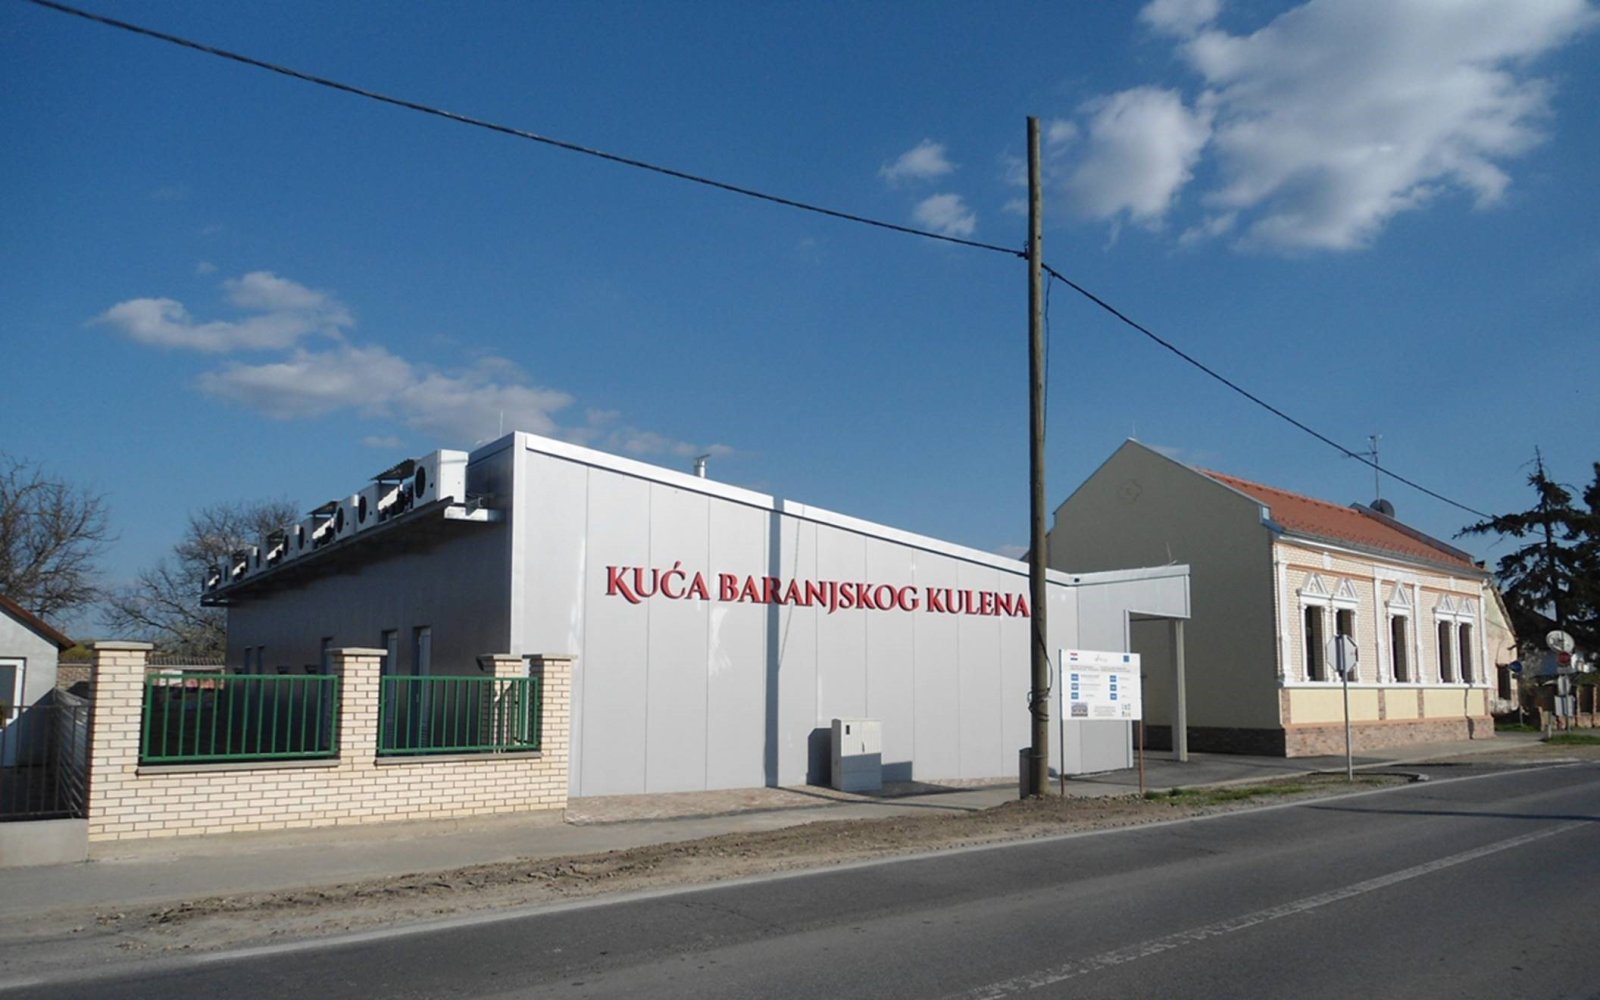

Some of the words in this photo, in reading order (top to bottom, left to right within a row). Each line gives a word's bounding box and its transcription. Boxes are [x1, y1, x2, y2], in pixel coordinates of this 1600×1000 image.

[606, 561, 711, 604] KUĆA
[718, 573, 921, 614] BARANJSKOG
[926, 587, 1031, 618] KULENA
